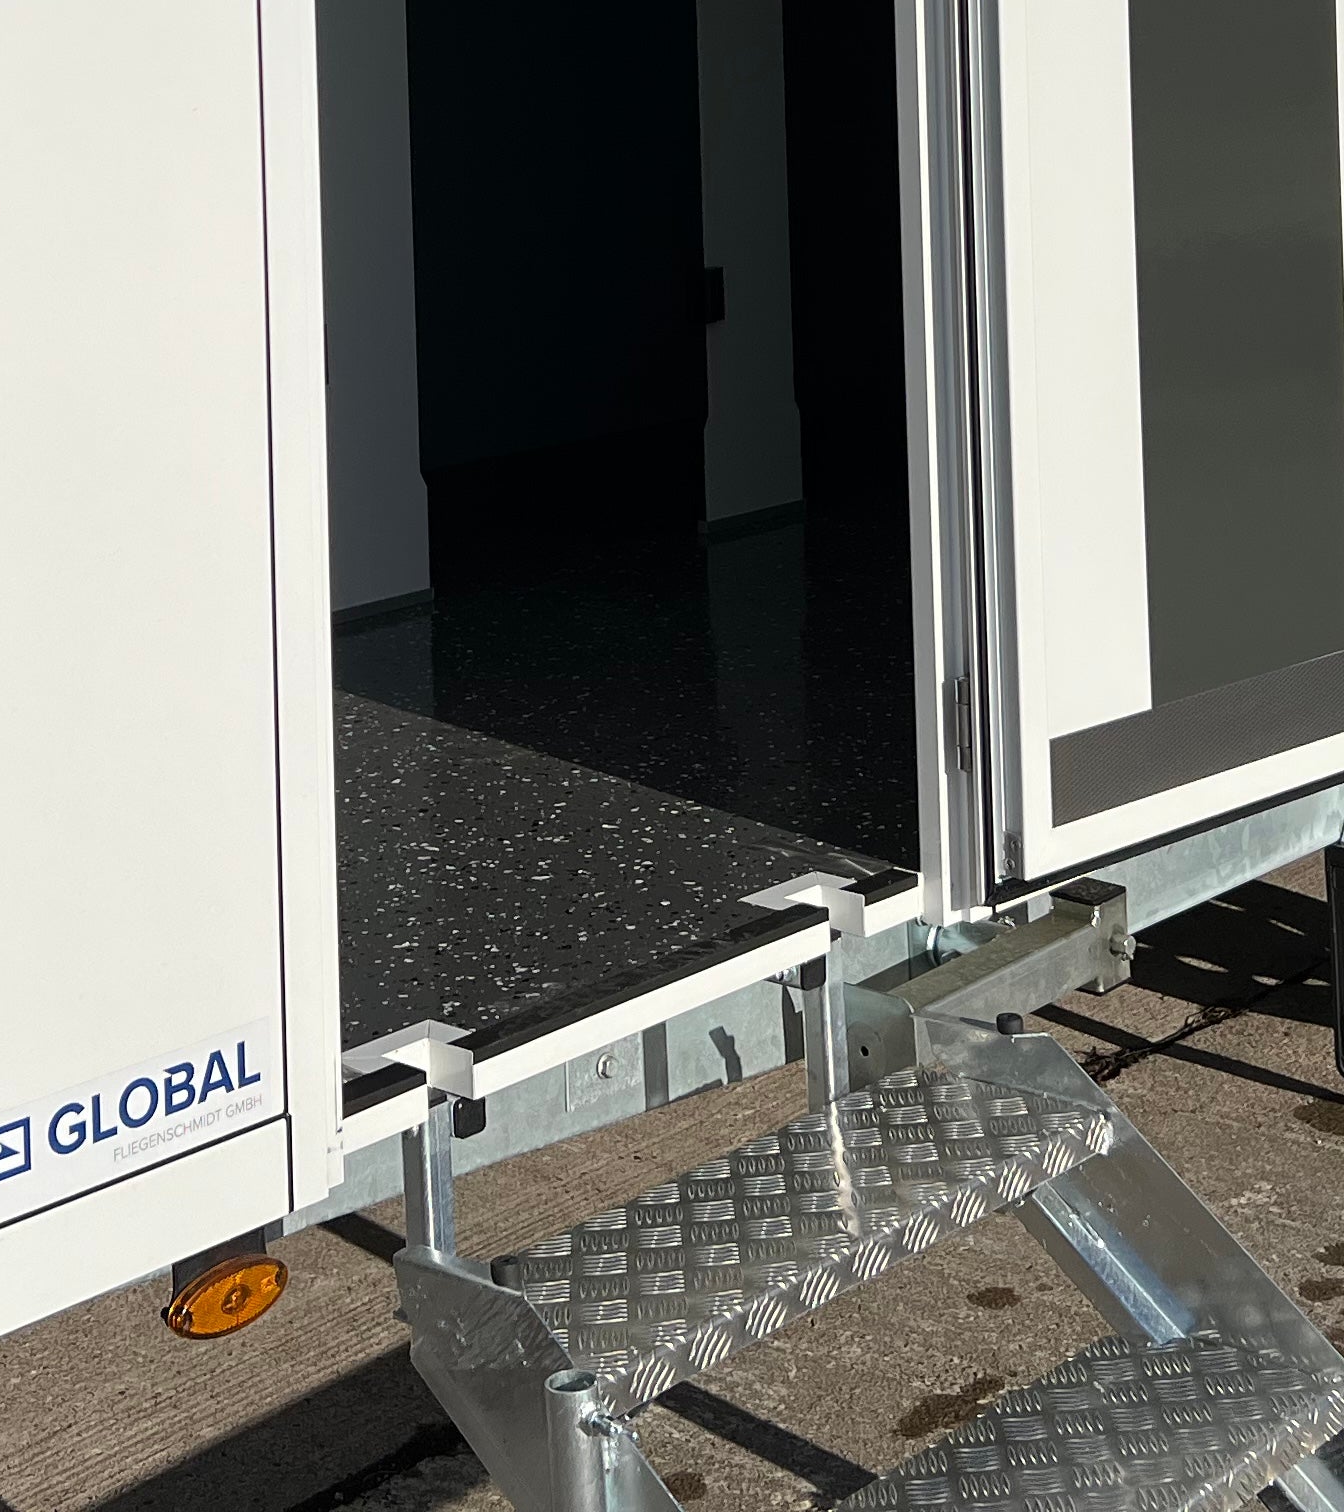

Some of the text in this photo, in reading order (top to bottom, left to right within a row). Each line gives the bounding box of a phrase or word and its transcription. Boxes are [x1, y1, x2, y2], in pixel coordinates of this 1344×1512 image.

[48, 1041, 261, 1155] GLOBAL
[113, 1094, 263, 1163] FLIEGENSCHMIDT GMBH
